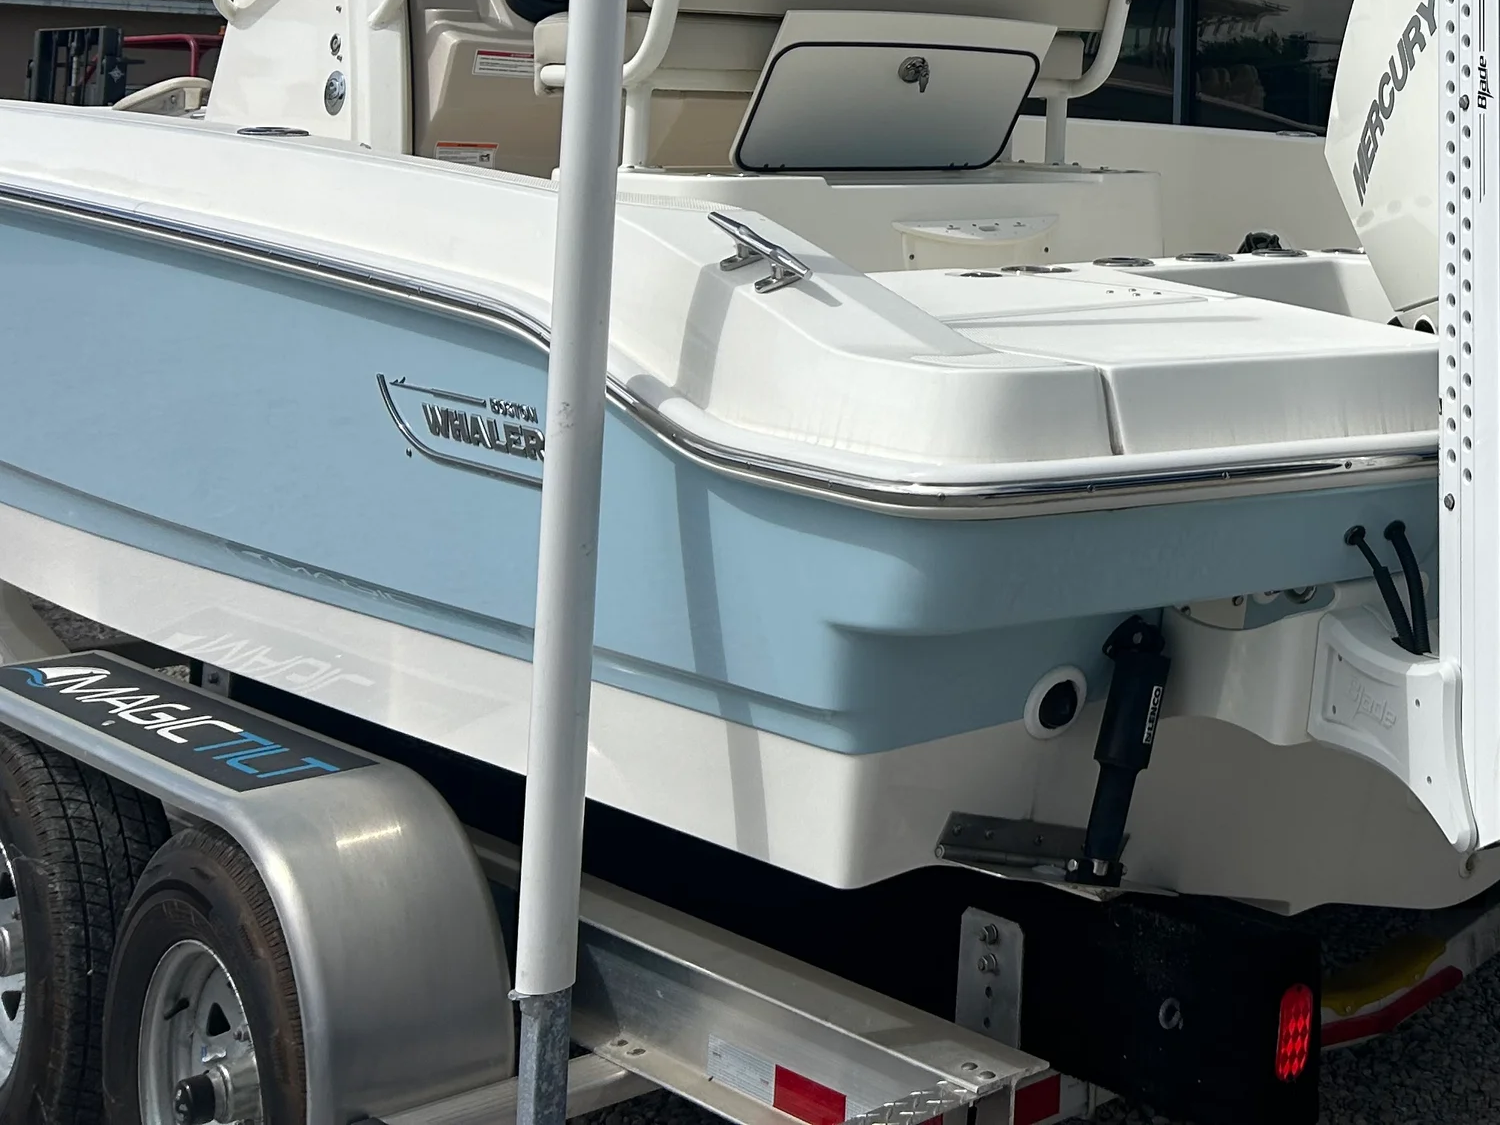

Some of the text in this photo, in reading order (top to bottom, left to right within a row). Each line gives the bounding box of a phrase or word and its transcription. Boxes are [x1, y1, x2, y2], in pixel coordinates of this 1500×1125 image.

[1477, 55, 1494, 109] Blade
[422, 402, 545, 462] WHALER
[489, 397, 538, 424] BOSTON
[1147, 686, 1162, 732] LENCO
[1347, 677, 1397, 731] Blade
